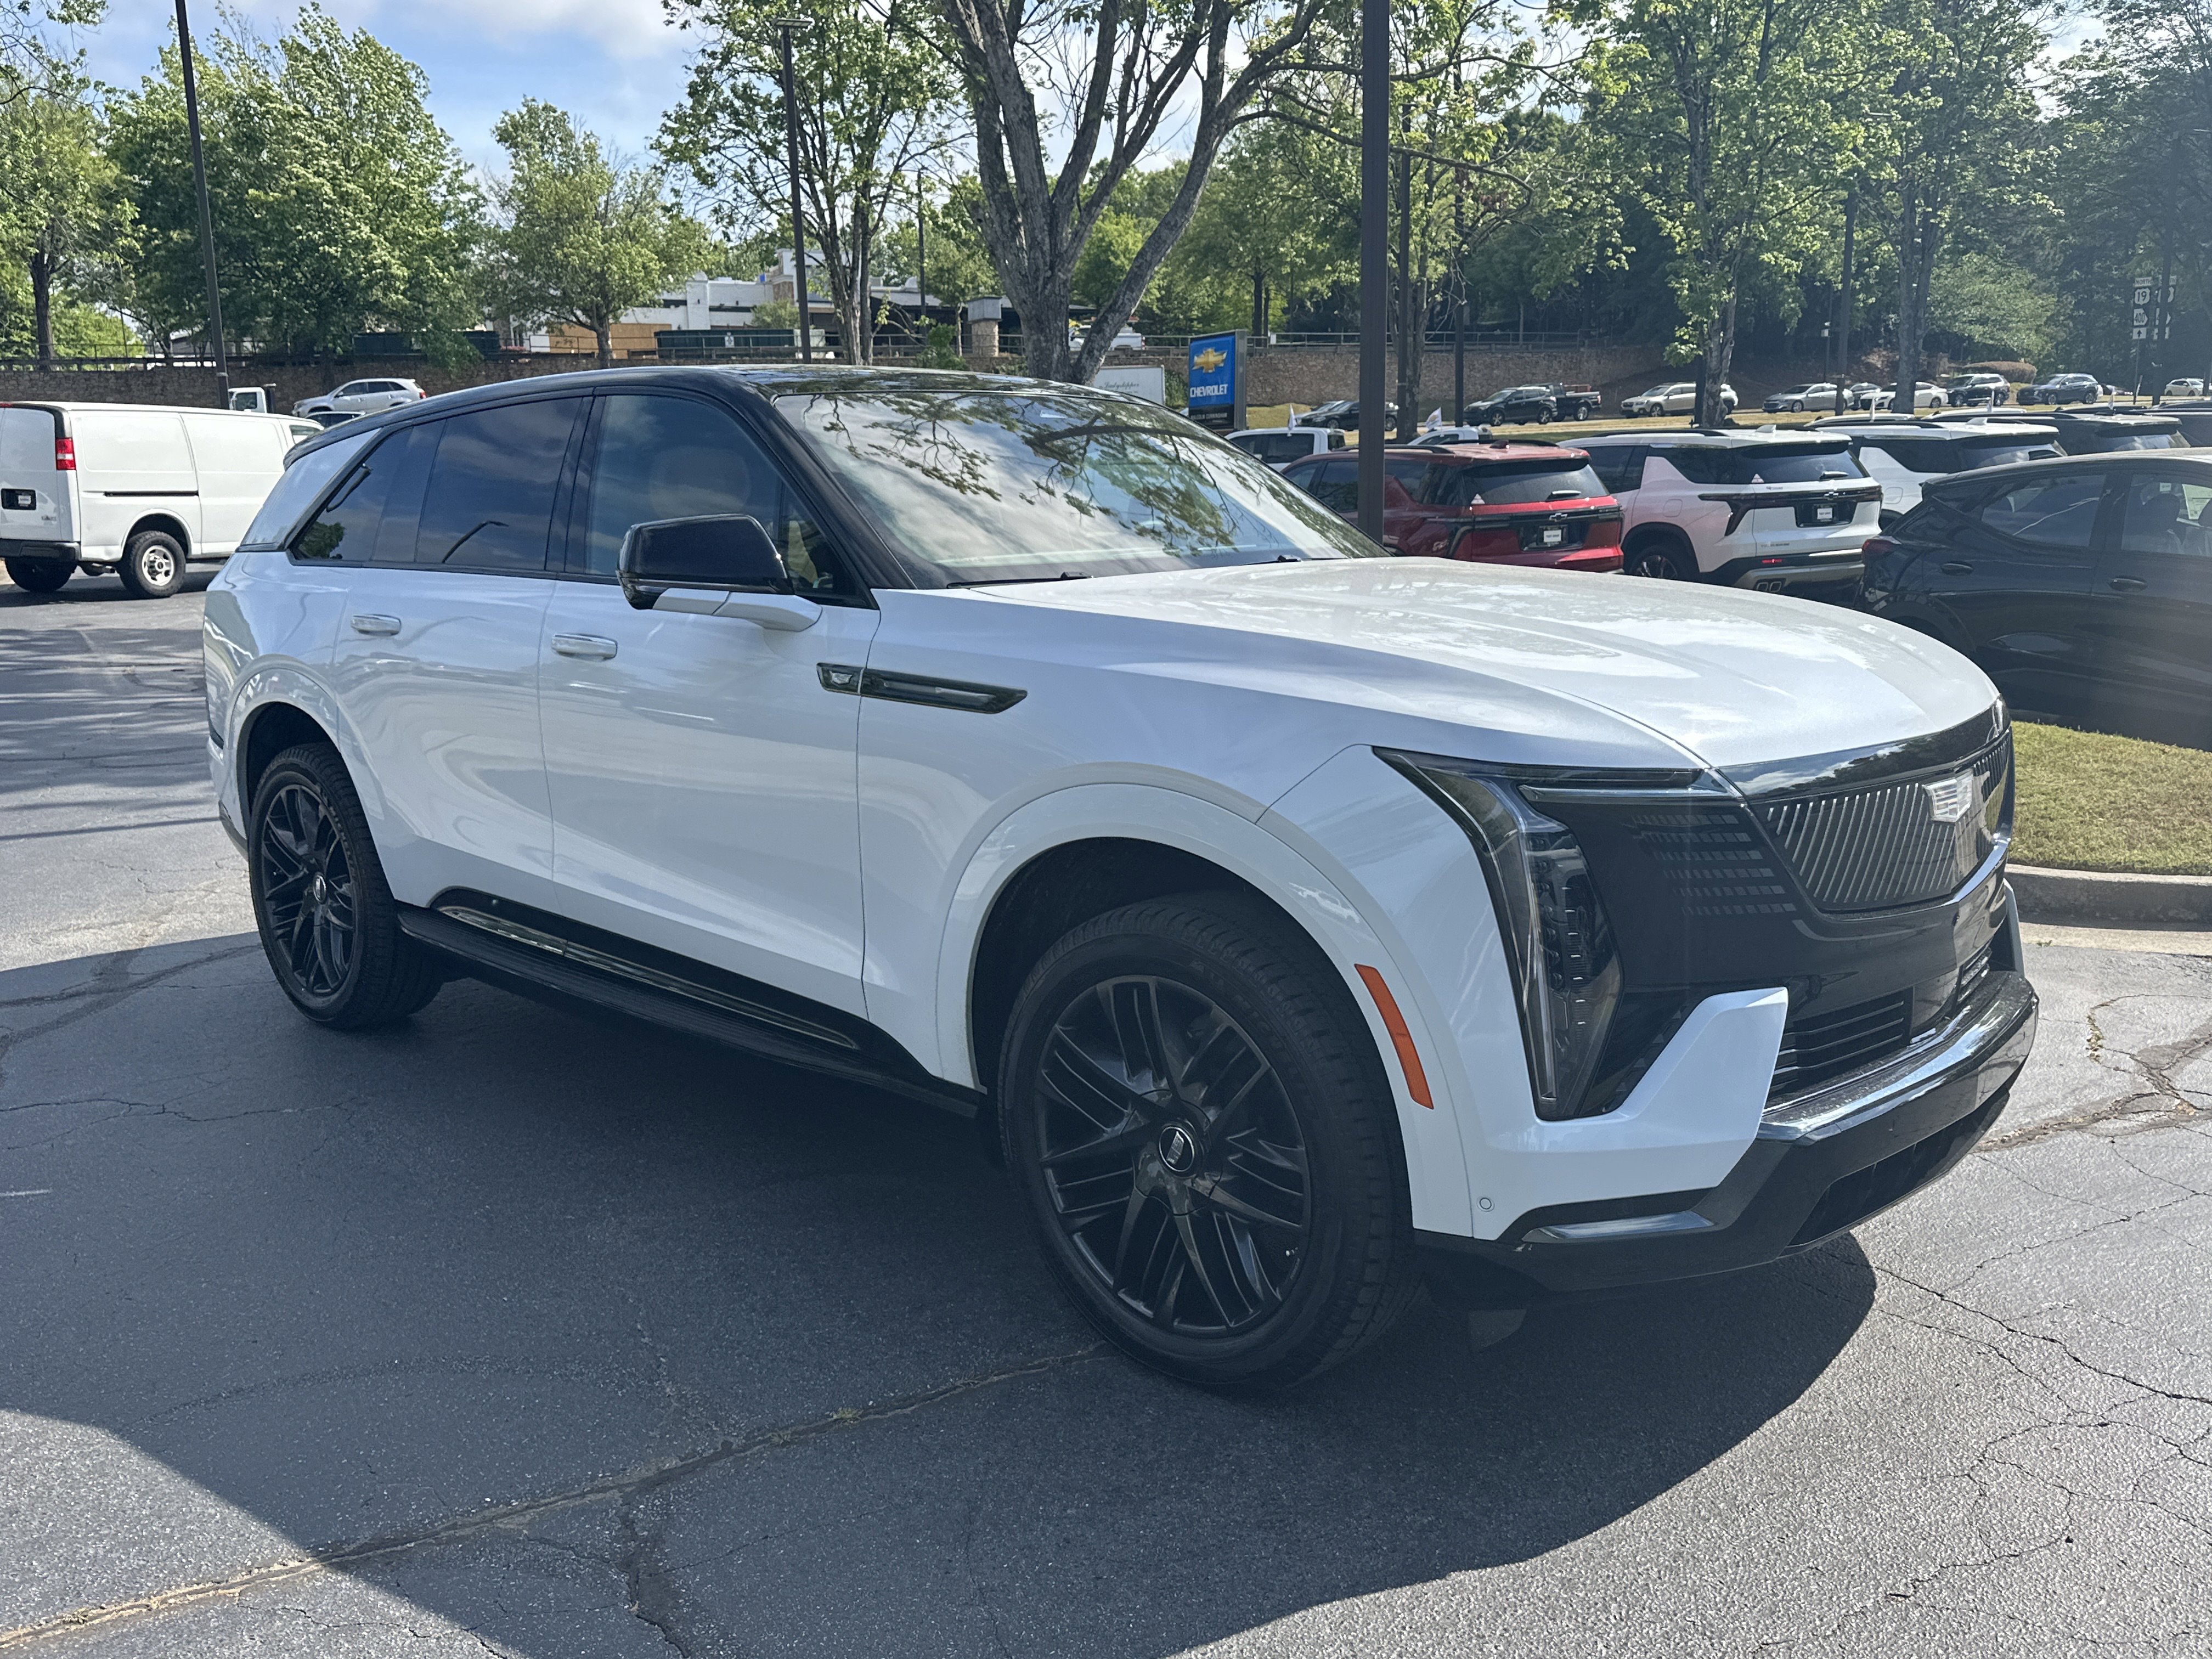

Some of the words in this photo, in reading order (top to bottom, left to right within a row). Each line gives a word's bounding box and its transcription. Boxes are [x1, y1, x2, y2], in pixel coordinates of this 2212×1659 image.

[2137, 291, 2147, 302] 19
[2134, 312, 2145, 323] 400
[1190, 384, 1228, 398] CHEVROLET
